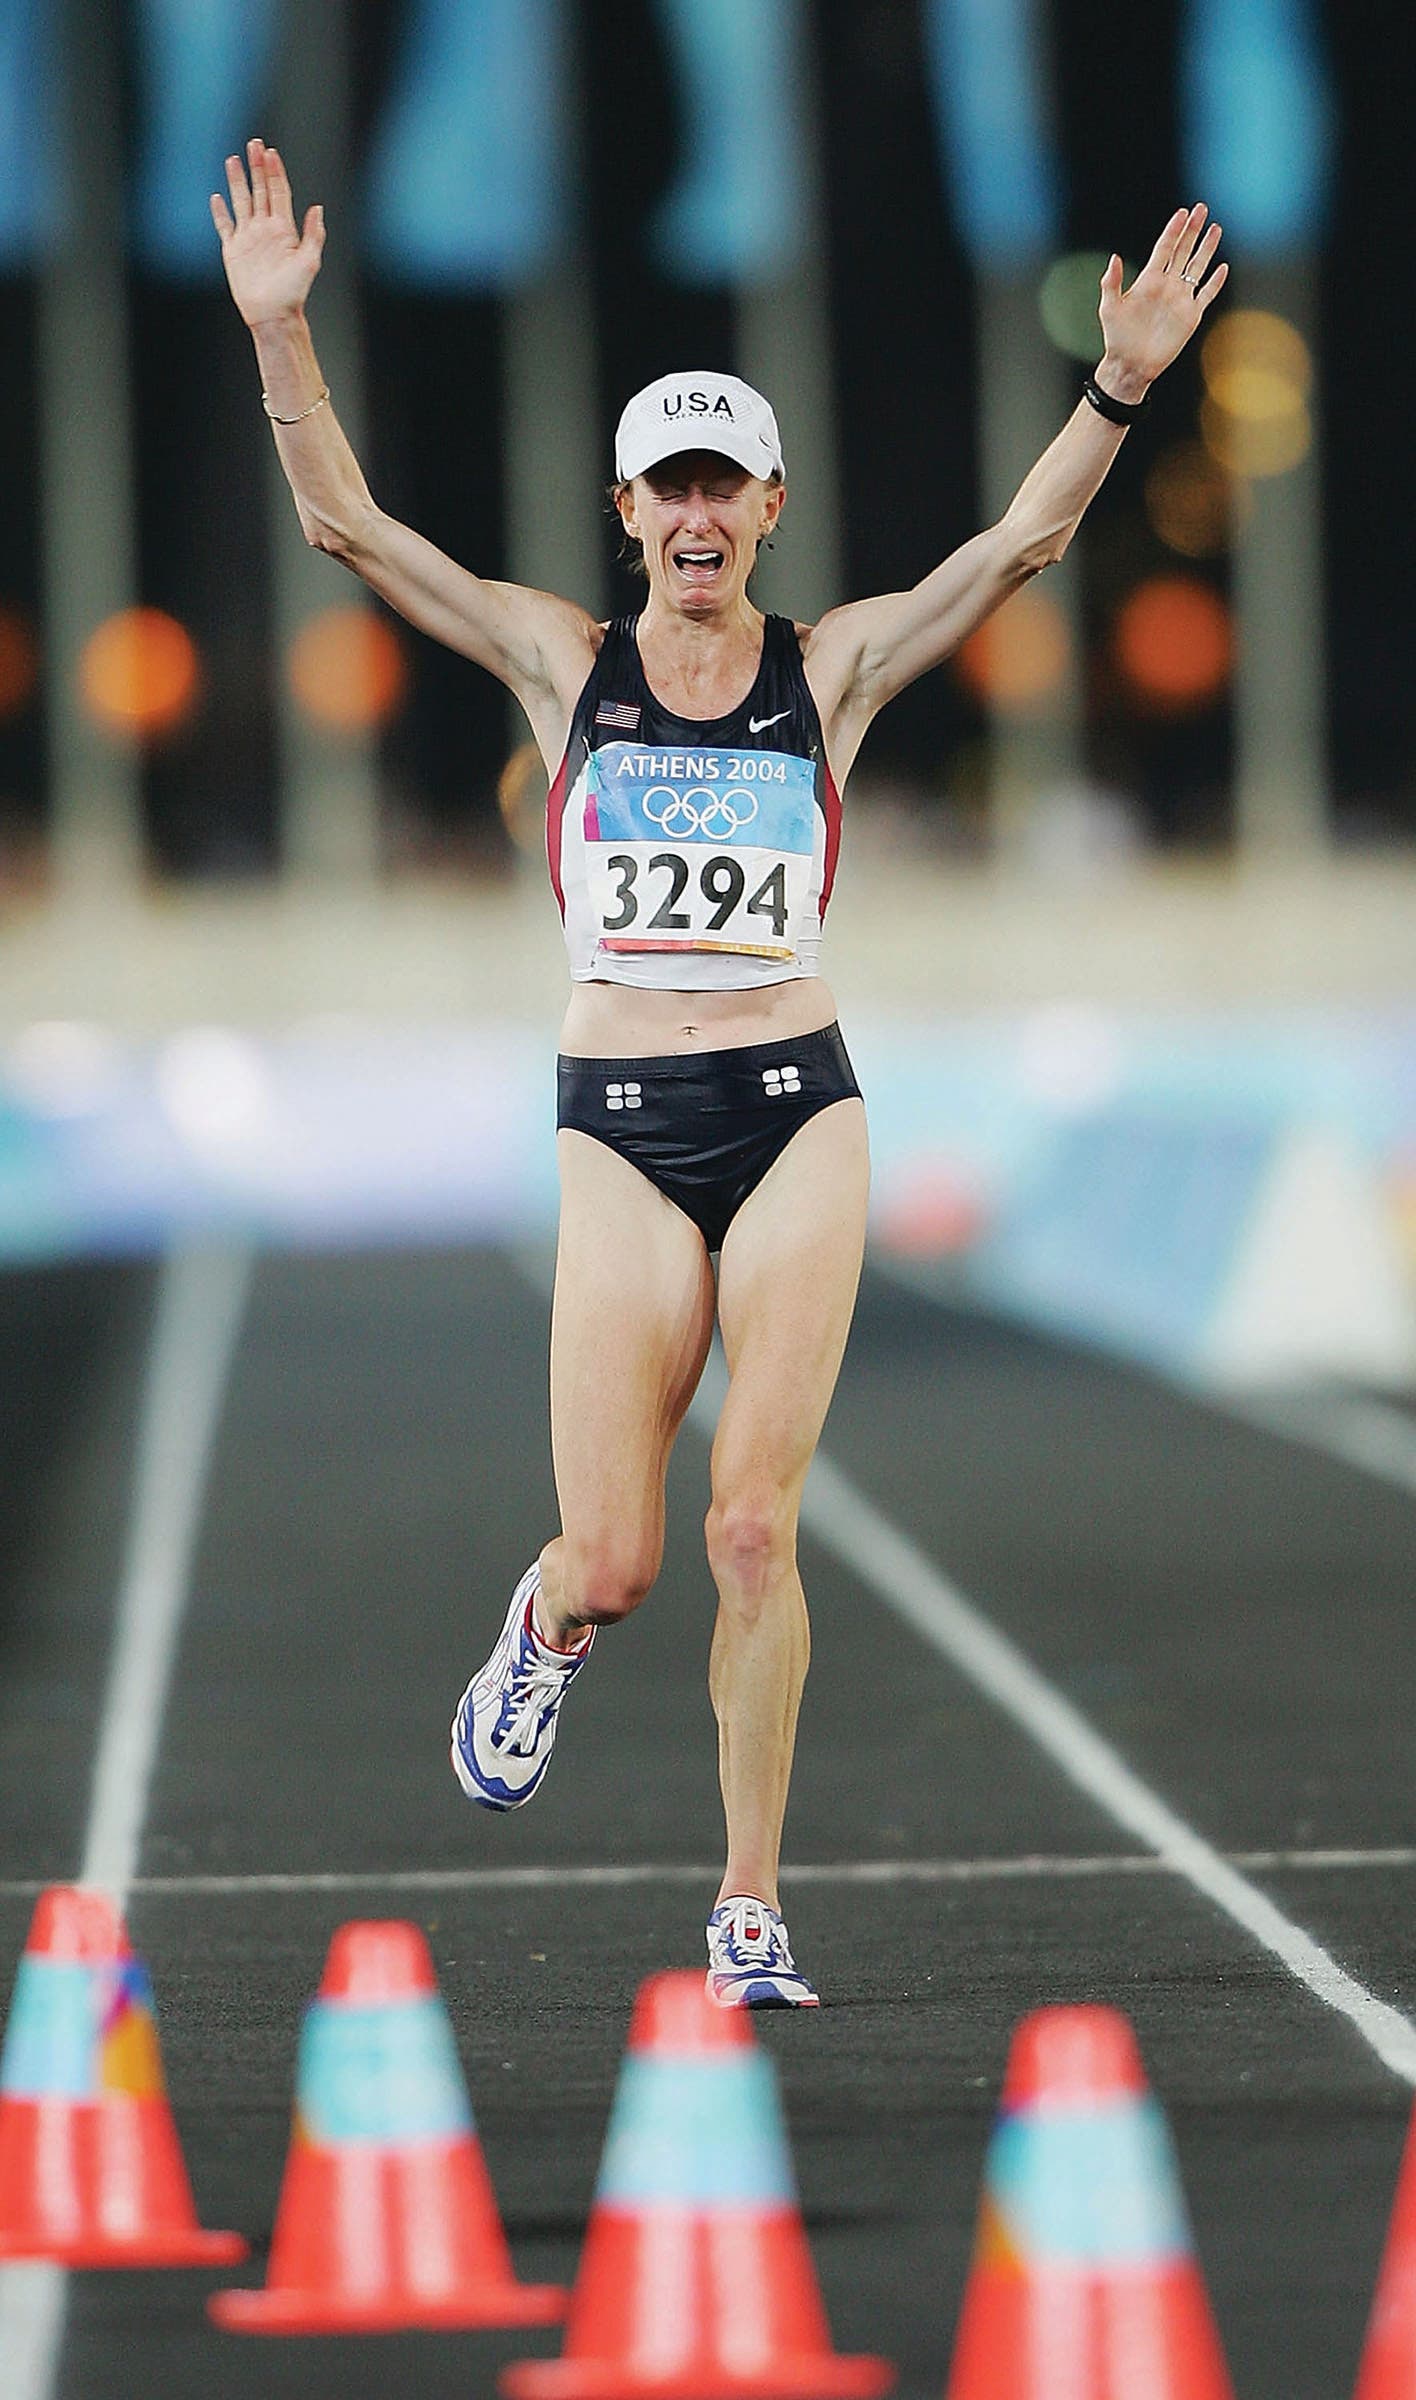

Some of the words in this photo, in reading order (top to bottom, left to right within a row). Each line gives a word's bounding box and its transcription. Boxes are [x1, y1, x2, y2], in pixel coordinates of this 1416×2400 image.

[663, 392, 734, 418] USA
[616, 755, 720, 780] ATHENS
[726, 758, 787, 784] 2004
[602, 853, 788, 937] 3294
